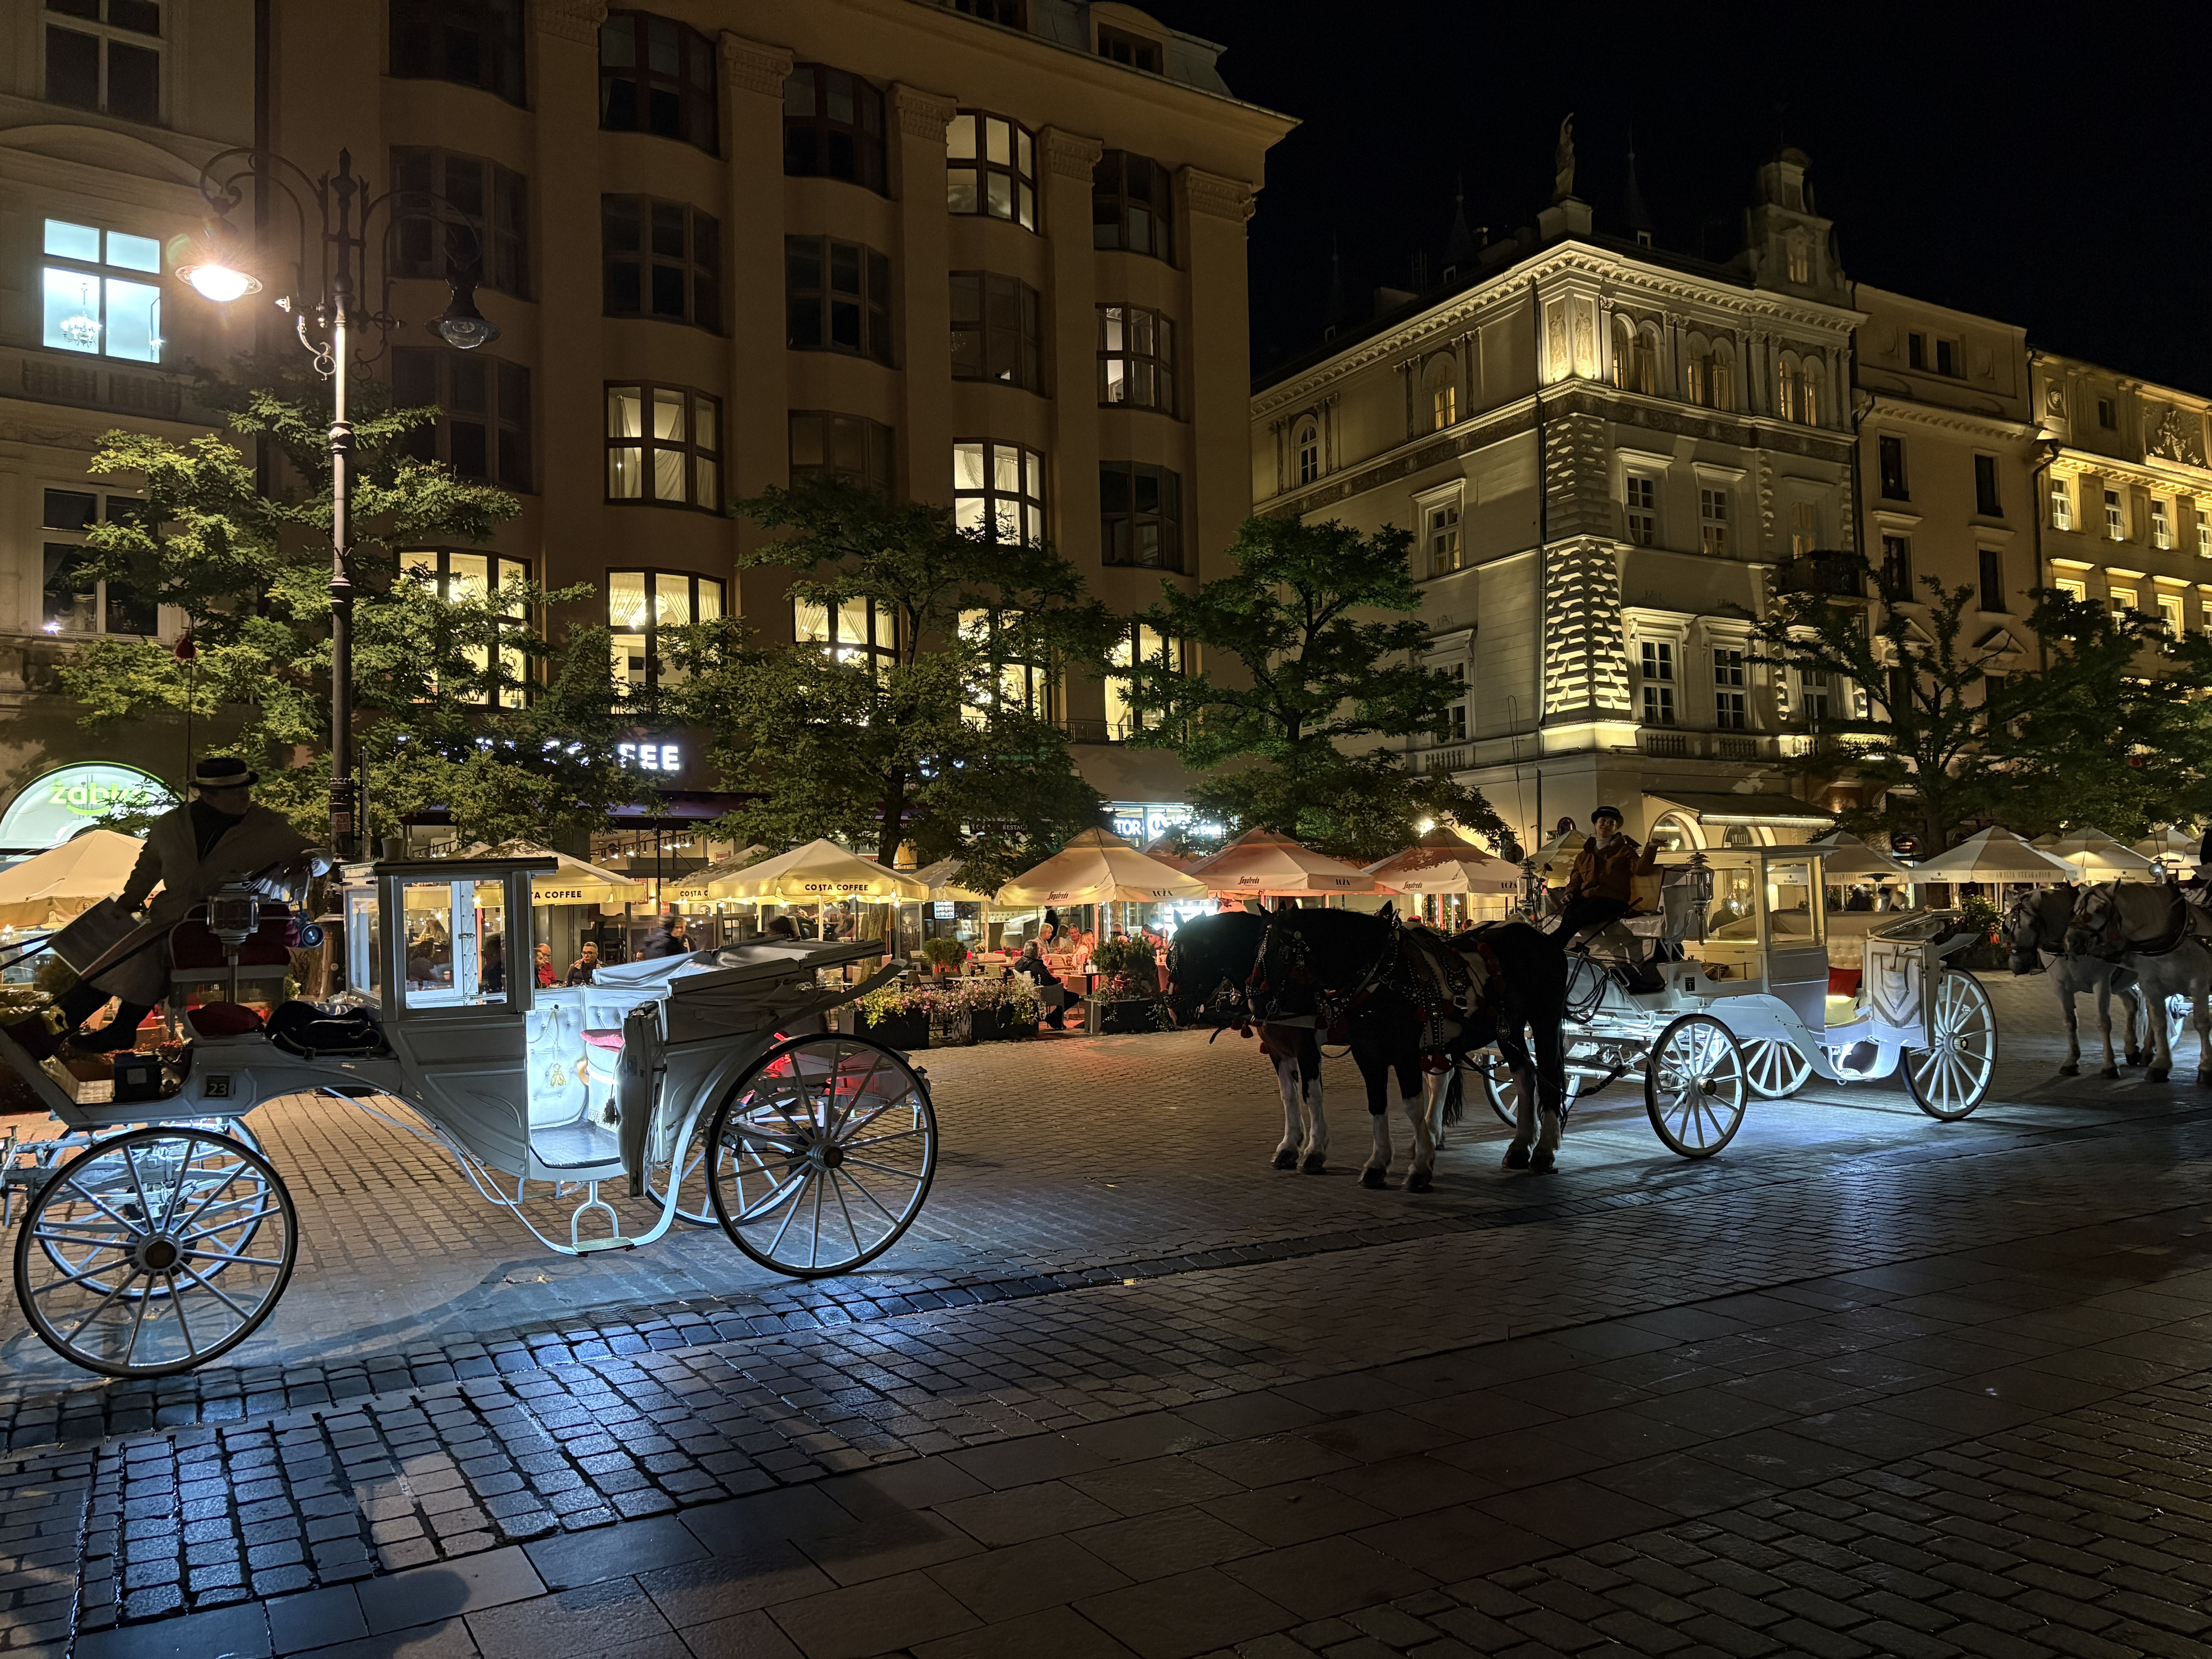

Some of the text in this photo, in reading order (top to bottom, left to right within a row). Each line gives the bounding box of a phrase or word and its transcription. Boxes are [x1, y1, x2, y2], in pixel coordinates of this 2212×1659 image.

[1114, 819, 1142, 836] TOR
[1238, 876, 1260, 885] Segafredo
[545, 890, 582, 899] COFFEE
[1047, 891, 1069, 900] Segafredo
[208, 1083, 227, 1095] 23
